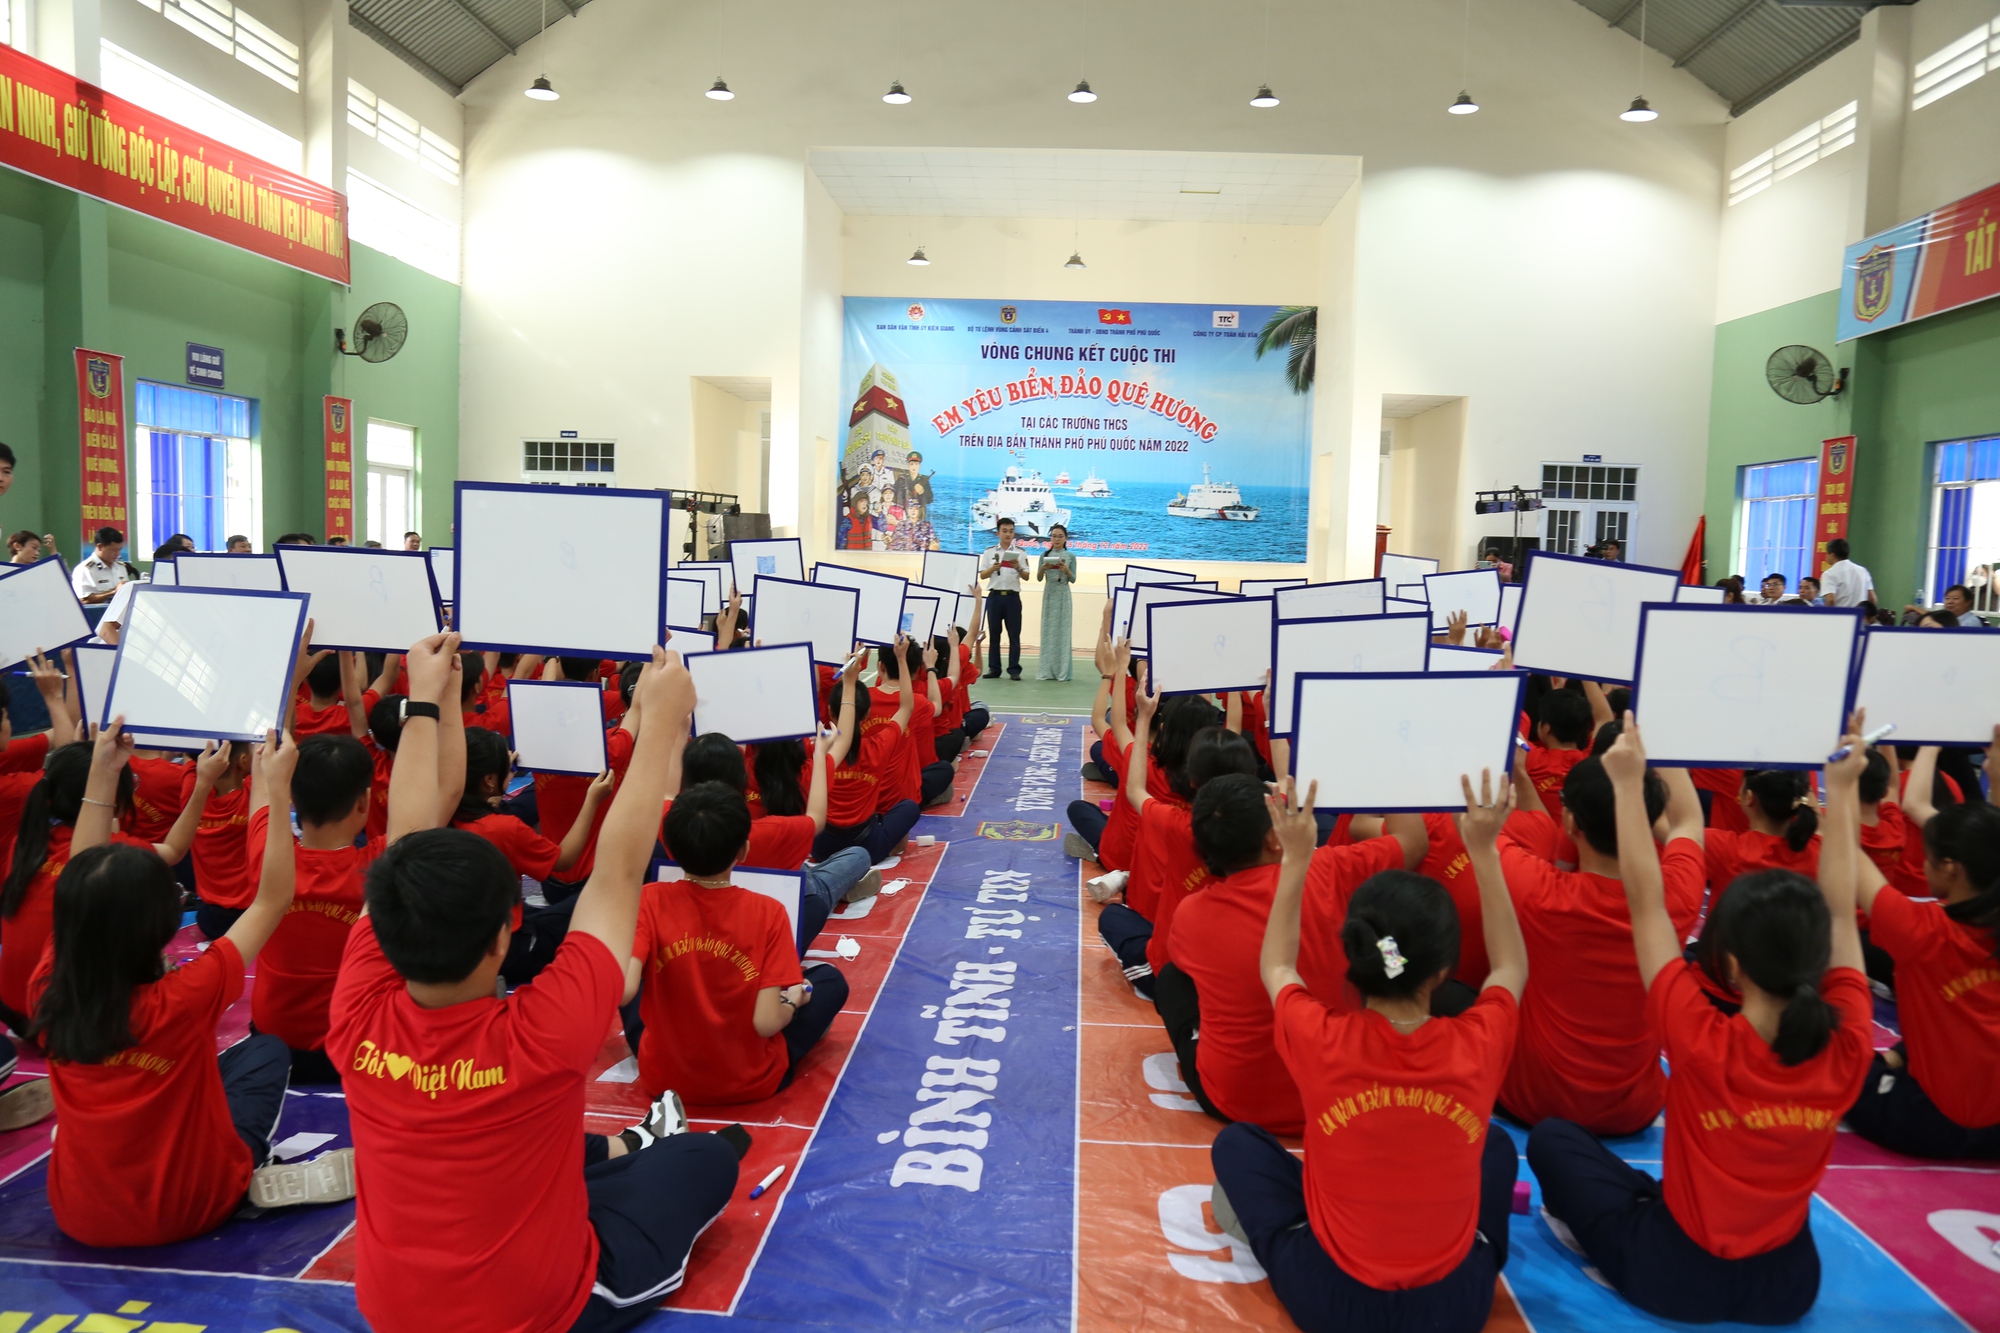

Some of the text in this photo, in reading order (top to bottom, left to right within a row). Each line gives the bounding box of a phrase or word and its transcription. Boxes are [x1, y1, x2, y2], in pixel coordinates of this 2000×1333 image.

[16, 82, 61, 157] NINH,
[64, 100, 89, 161] GIỮ
[91, 109, 127, 176] VỮNG
[129, 125, 154, 194] ĐỘC
[157, 137, 181, 203] LẬP,
[183, 147, 205, 206] CHỦ
[257, 183, 281, 236] TOÀN
[282, 197, 300, 249] VẸN
[1965, 208, 1997, 276] TẤT
[981, 341, 1175, 365] VÒNG CHUNG KẾT CUỘC THI
[189, 365, 196, 377] VỆ
[84, 403, 96, 423] ĐẢO
[932, 367, 1218, 440] EM YÊU BIỂN, ĐẢO QUÊ HƯƠNG
[1021, 415, 1128, 431] TẠI CÁC TRƯỜNG THCS
[86, 427, 100, 447] BIỂN
[959, 433, 984, 447] TRÊN
[987, 436, 1003, 450] ĐỊA
[1065, 434, 1084, 449] PHỐ
[1087, 436, 1106, 450] PHÚ
[1110, 435, 1136, 451] QUỐC
[1139, 437, 1162, 451] NĂM
[1165, 441, 1189, 452] 2022
[86, 454, 98, 472] QUÊ
[87, 479, 103, 496] QUÂN
[108, 480, 119, 497] DÂN
[114, 503, 125, 520] ĐẢO
[1129, 542, 1148, 550] 2022
[977, 869, 1032, 904] TIN
[963, 906, 1041, 940] TỰ
[988, 946, 1004, 955] -
[919, 960, 1017, 1045] TĨNH
[353, 1039, 507, 1100] Tôi Việt Nam
[876, 1055, 1000, 1192] BÌNH
